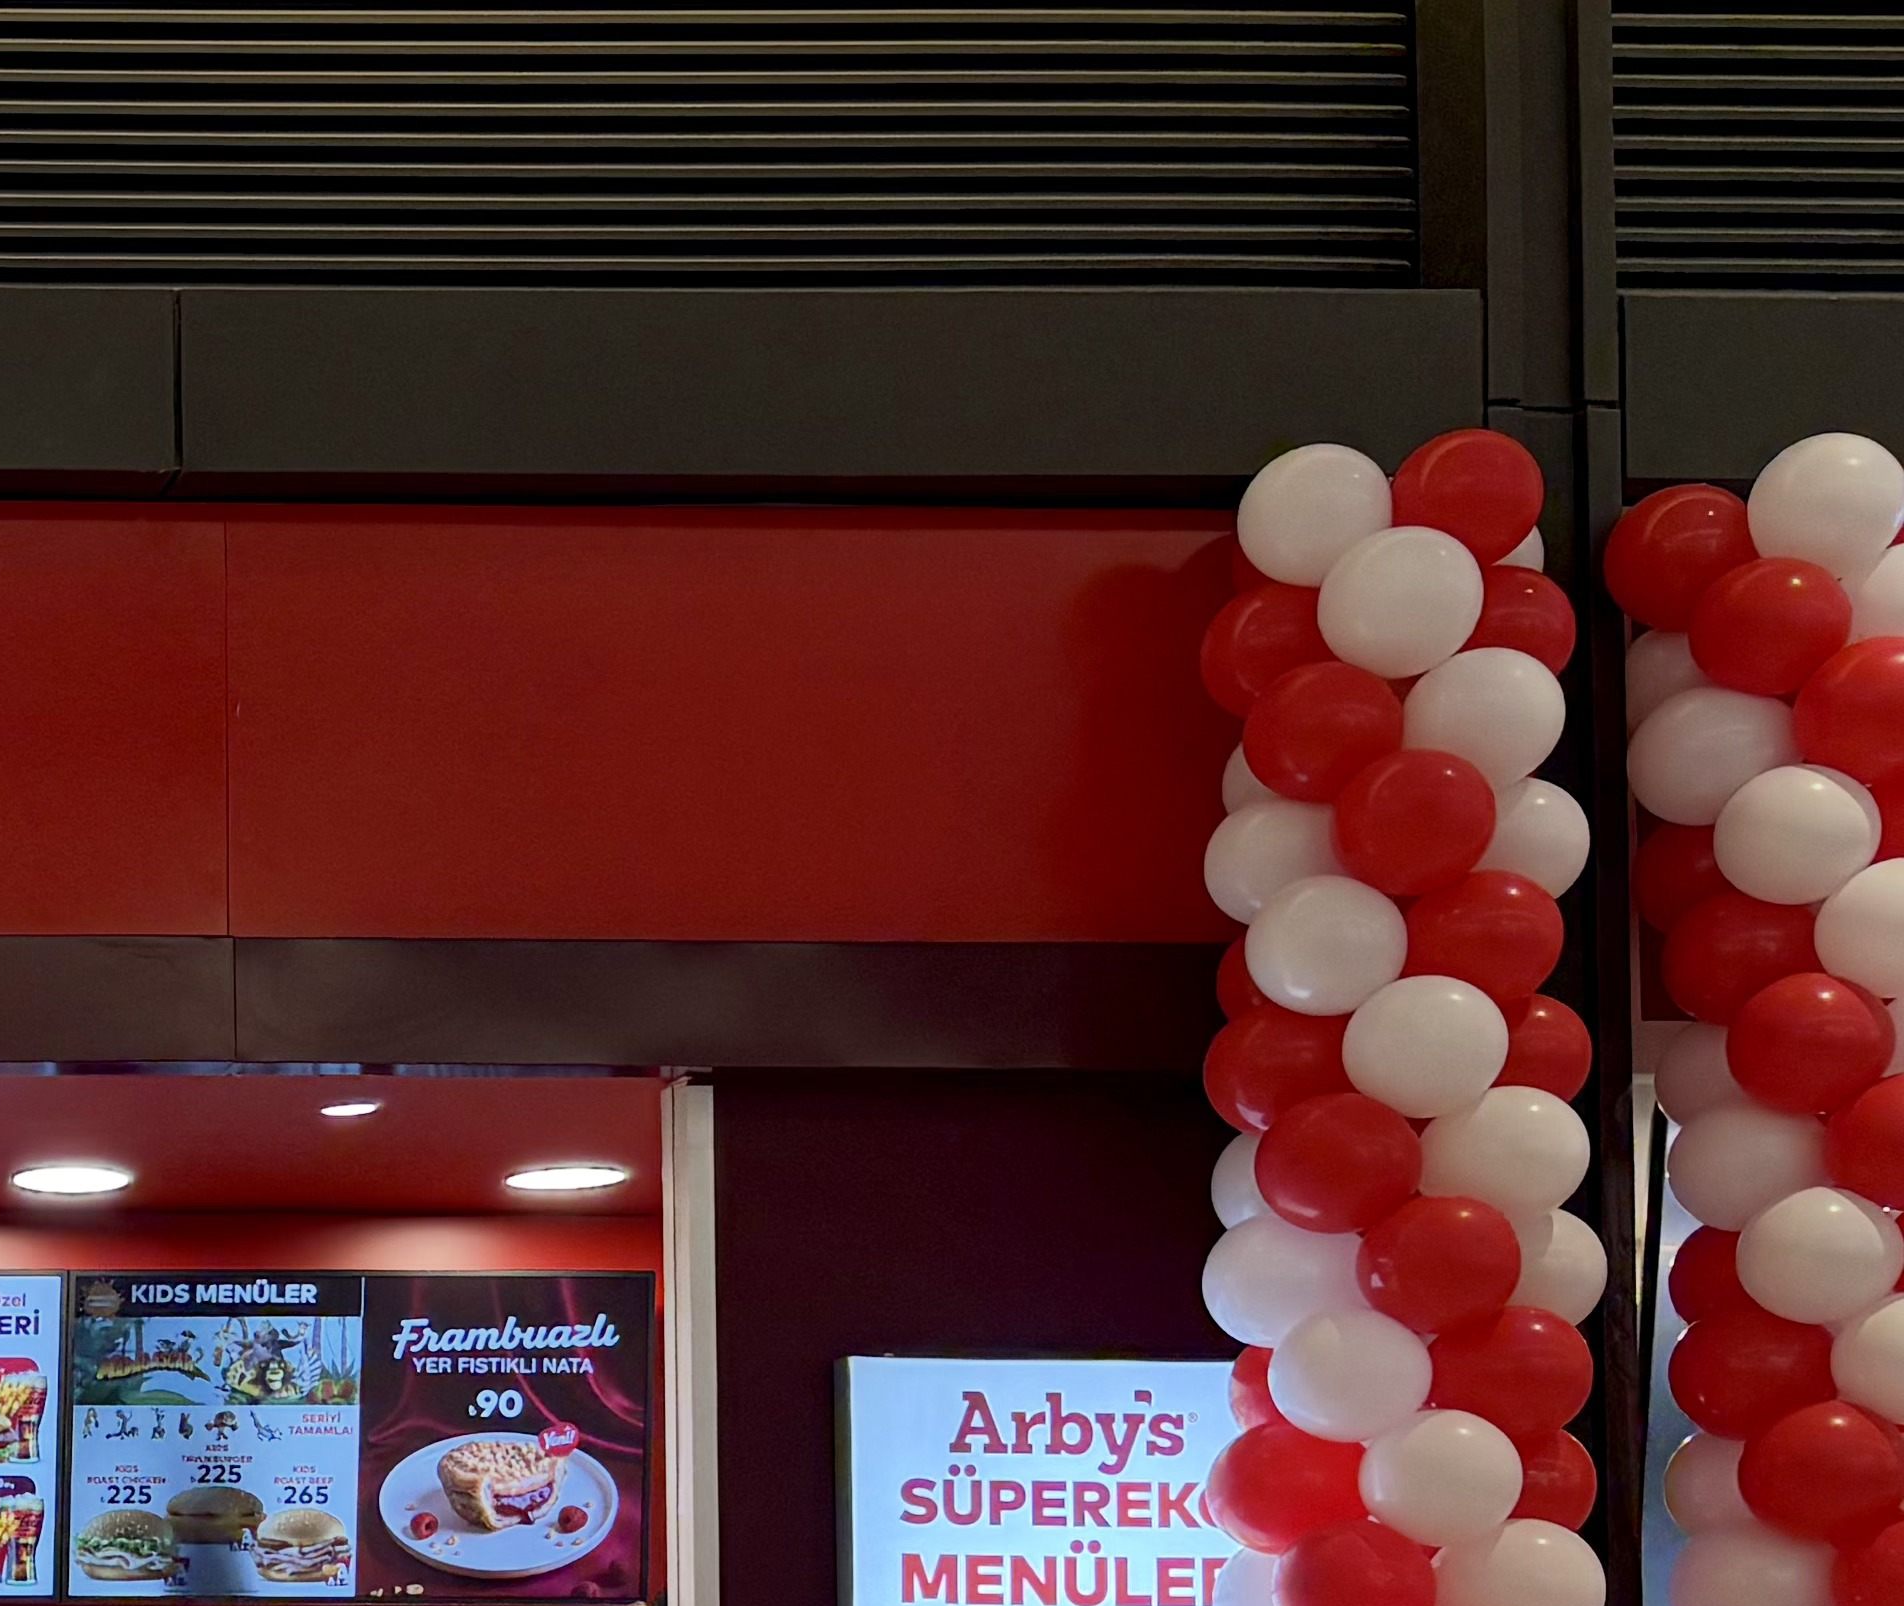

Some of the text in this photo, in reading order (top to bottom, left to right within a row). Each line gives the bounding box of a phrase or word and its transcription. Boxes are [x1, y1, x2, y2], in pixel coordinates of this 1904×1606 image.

[132, 1279, 317, 1303] KIDS MENÜLER
[392, 1313, 620, 1359] Frambuazlı
[413, 1358, 593, 1373] YER FISTIKLI NATA
[949, 1390, 1184, 1475] Arby's
